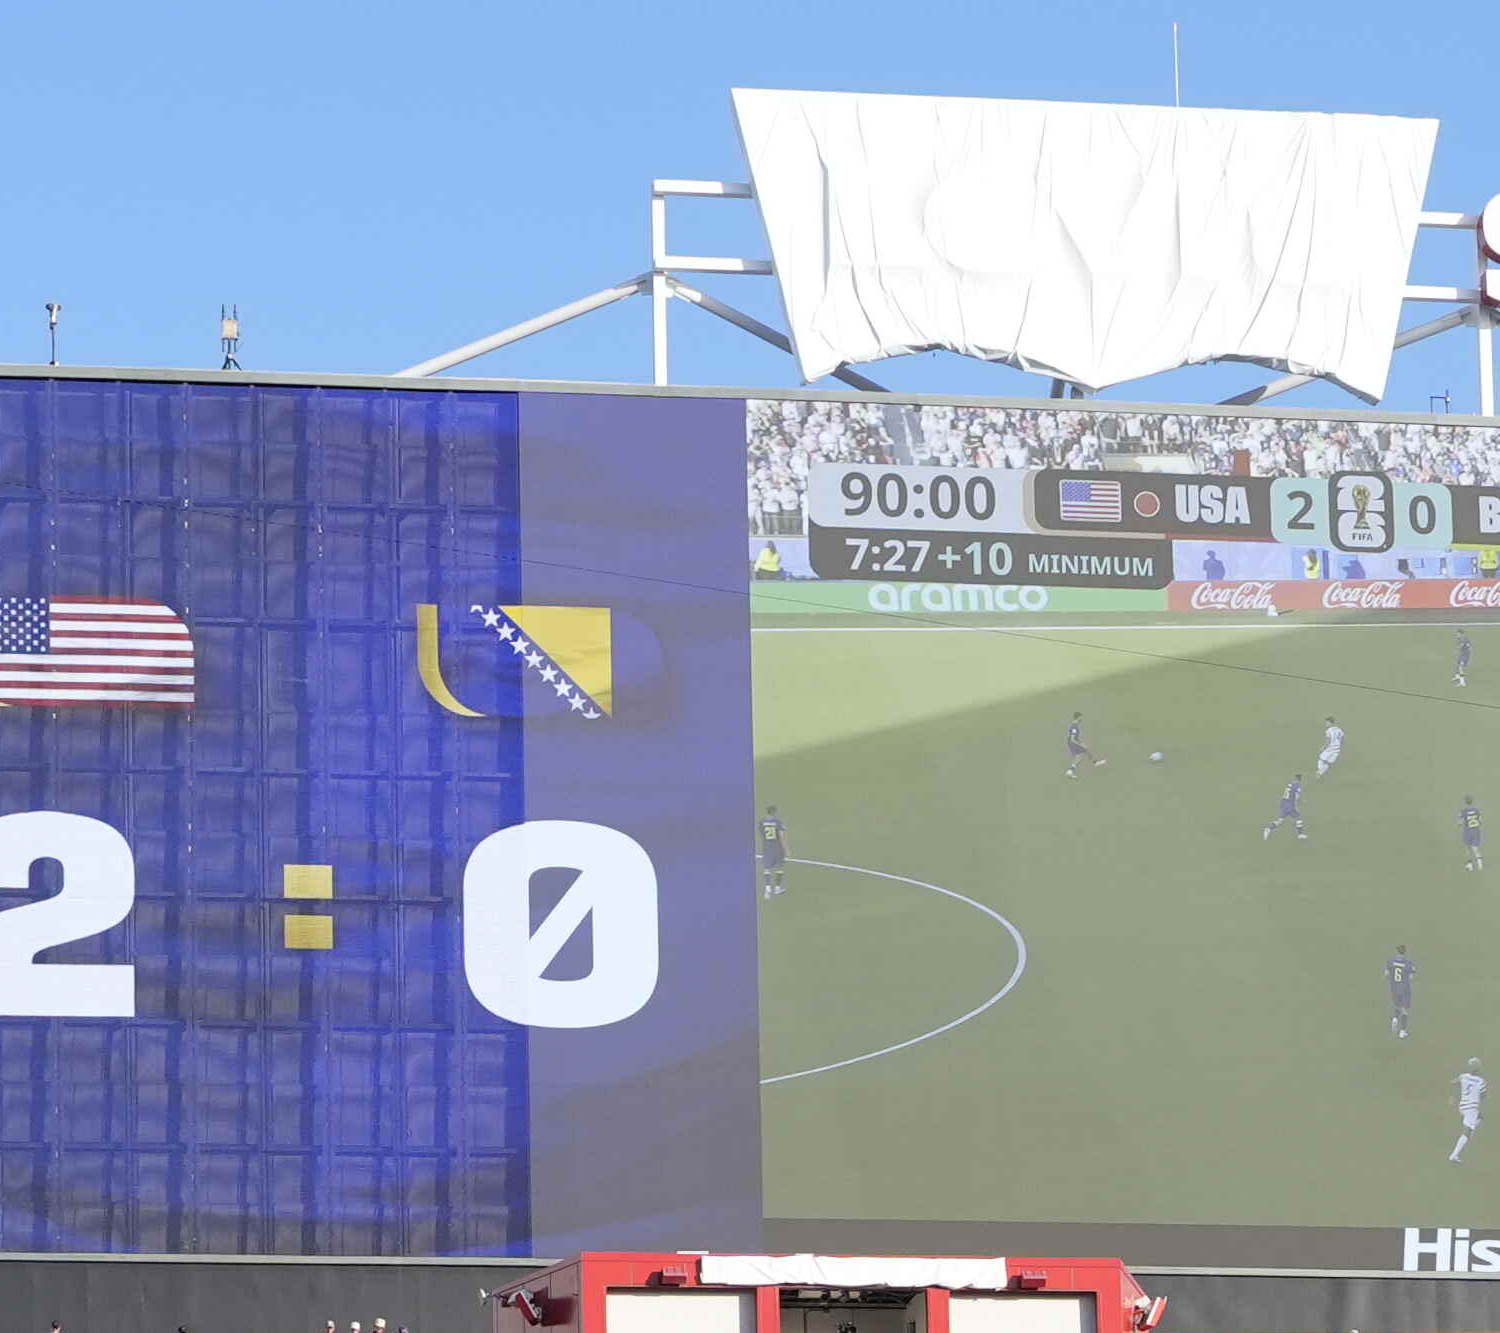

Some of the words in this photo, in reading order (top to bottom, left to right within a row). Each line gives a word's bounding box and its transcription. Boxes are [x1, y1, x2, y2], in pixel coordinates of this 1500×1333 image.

[840, 471, 996, 521] 90:00
[1174, 483, 1252, 526] USA
[1286, 490, 1316, 531] 2
[1408, 494, 1437, 536] 0
[844, 537, 931, 573] 7:27
[937, 541, 1013, 576] +10
[1028, 553, 1154, 577] MINIMUM
[1352, 532, 1374, 543] FIFA
[868, 582, 1049, 613] aramco
[1191, 581, 1274, 609] Coca-Cola
[1322, 581, 1403, 609] Coca-Cola
[462, 819, 660, 1029] 0
